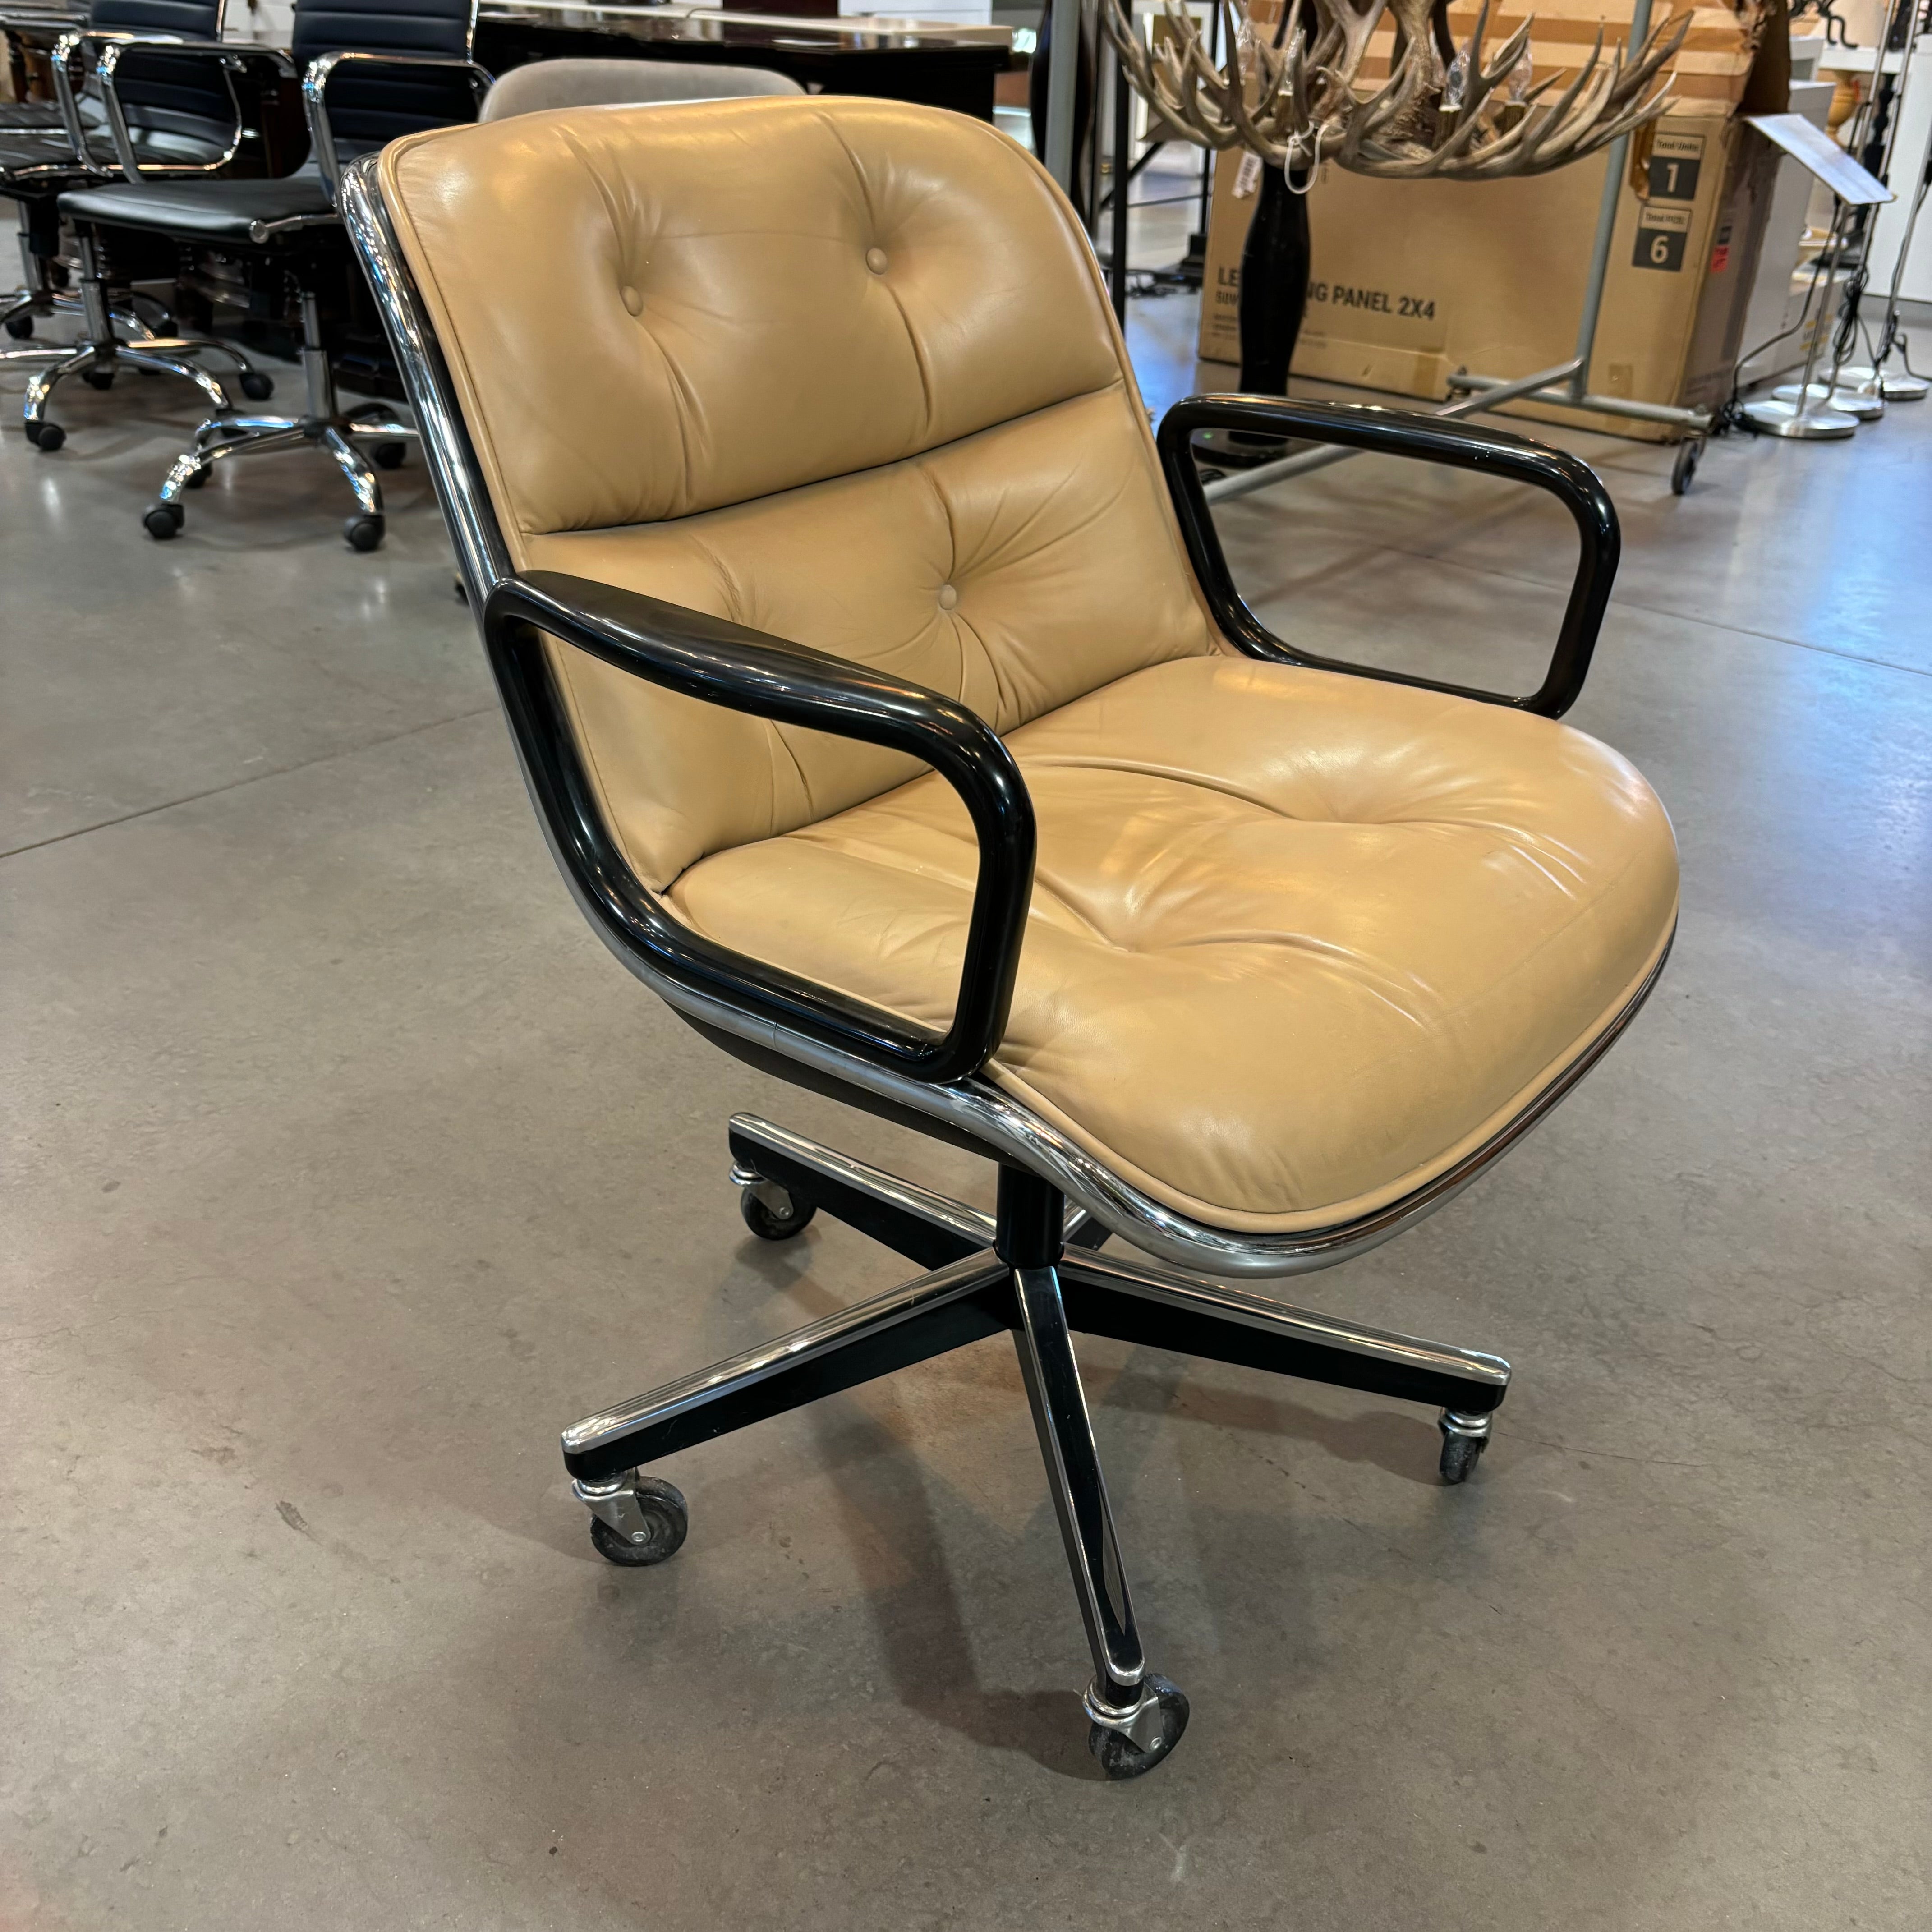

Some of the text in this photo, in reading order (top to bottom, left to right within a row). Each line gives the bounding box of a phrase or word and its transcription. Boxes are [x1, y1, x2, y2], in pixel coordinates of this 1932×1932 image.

[1667, 163, 1679, 193] 1
[1651, 235, 1669, 263] 6
[1218, 266, 1239, 287] LE
[1332, 285, 1392, 314] PANEL
[1397, 295, 1435, 320] 2X4
